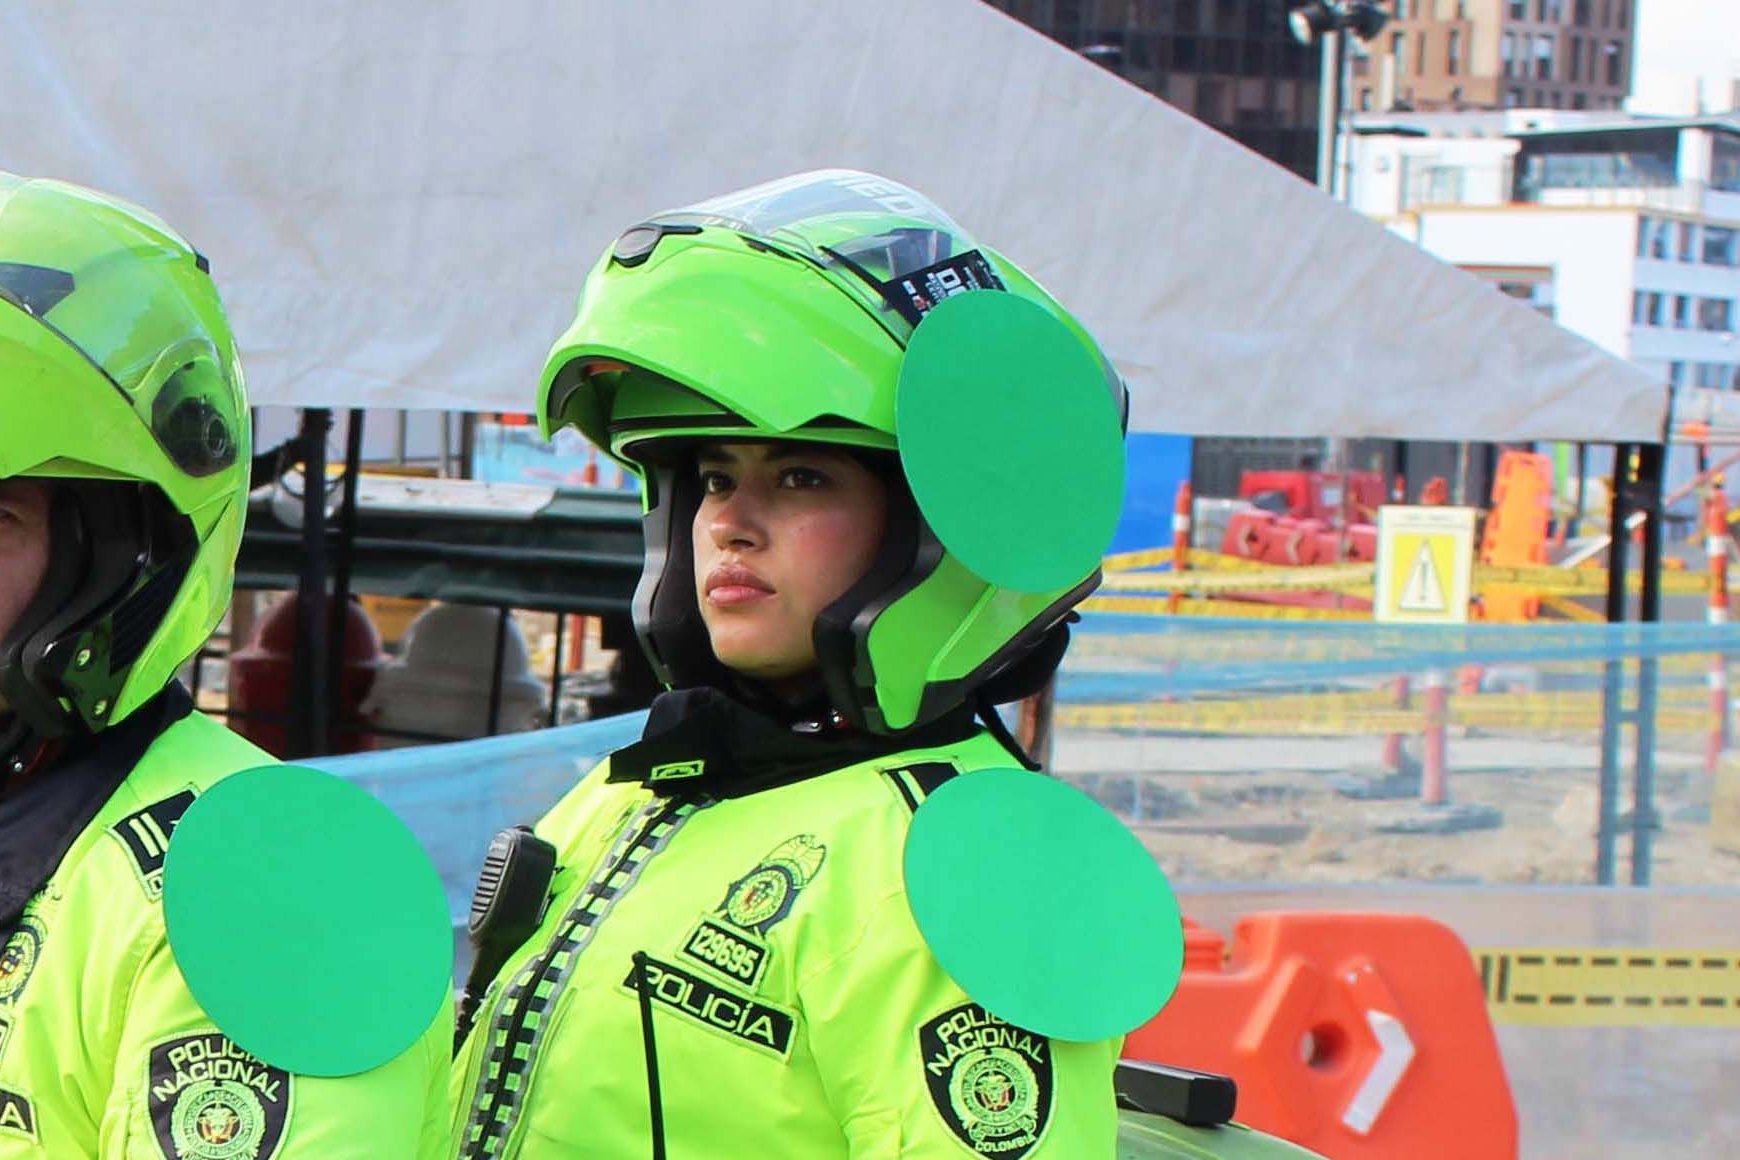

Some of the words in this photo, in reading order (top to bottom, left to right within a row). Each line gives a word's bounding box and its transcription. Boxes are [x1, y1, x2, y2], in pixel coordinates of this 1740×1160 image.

[688, 924, 760, 980] 129695
[936, 1008, 1009, 1043] POLI
[167, 1037, 269, 1071] POLIC
[927, 1027, 1044, 1077] NACIONAL
[152, 1059, 281, 1102] NACIONAL
